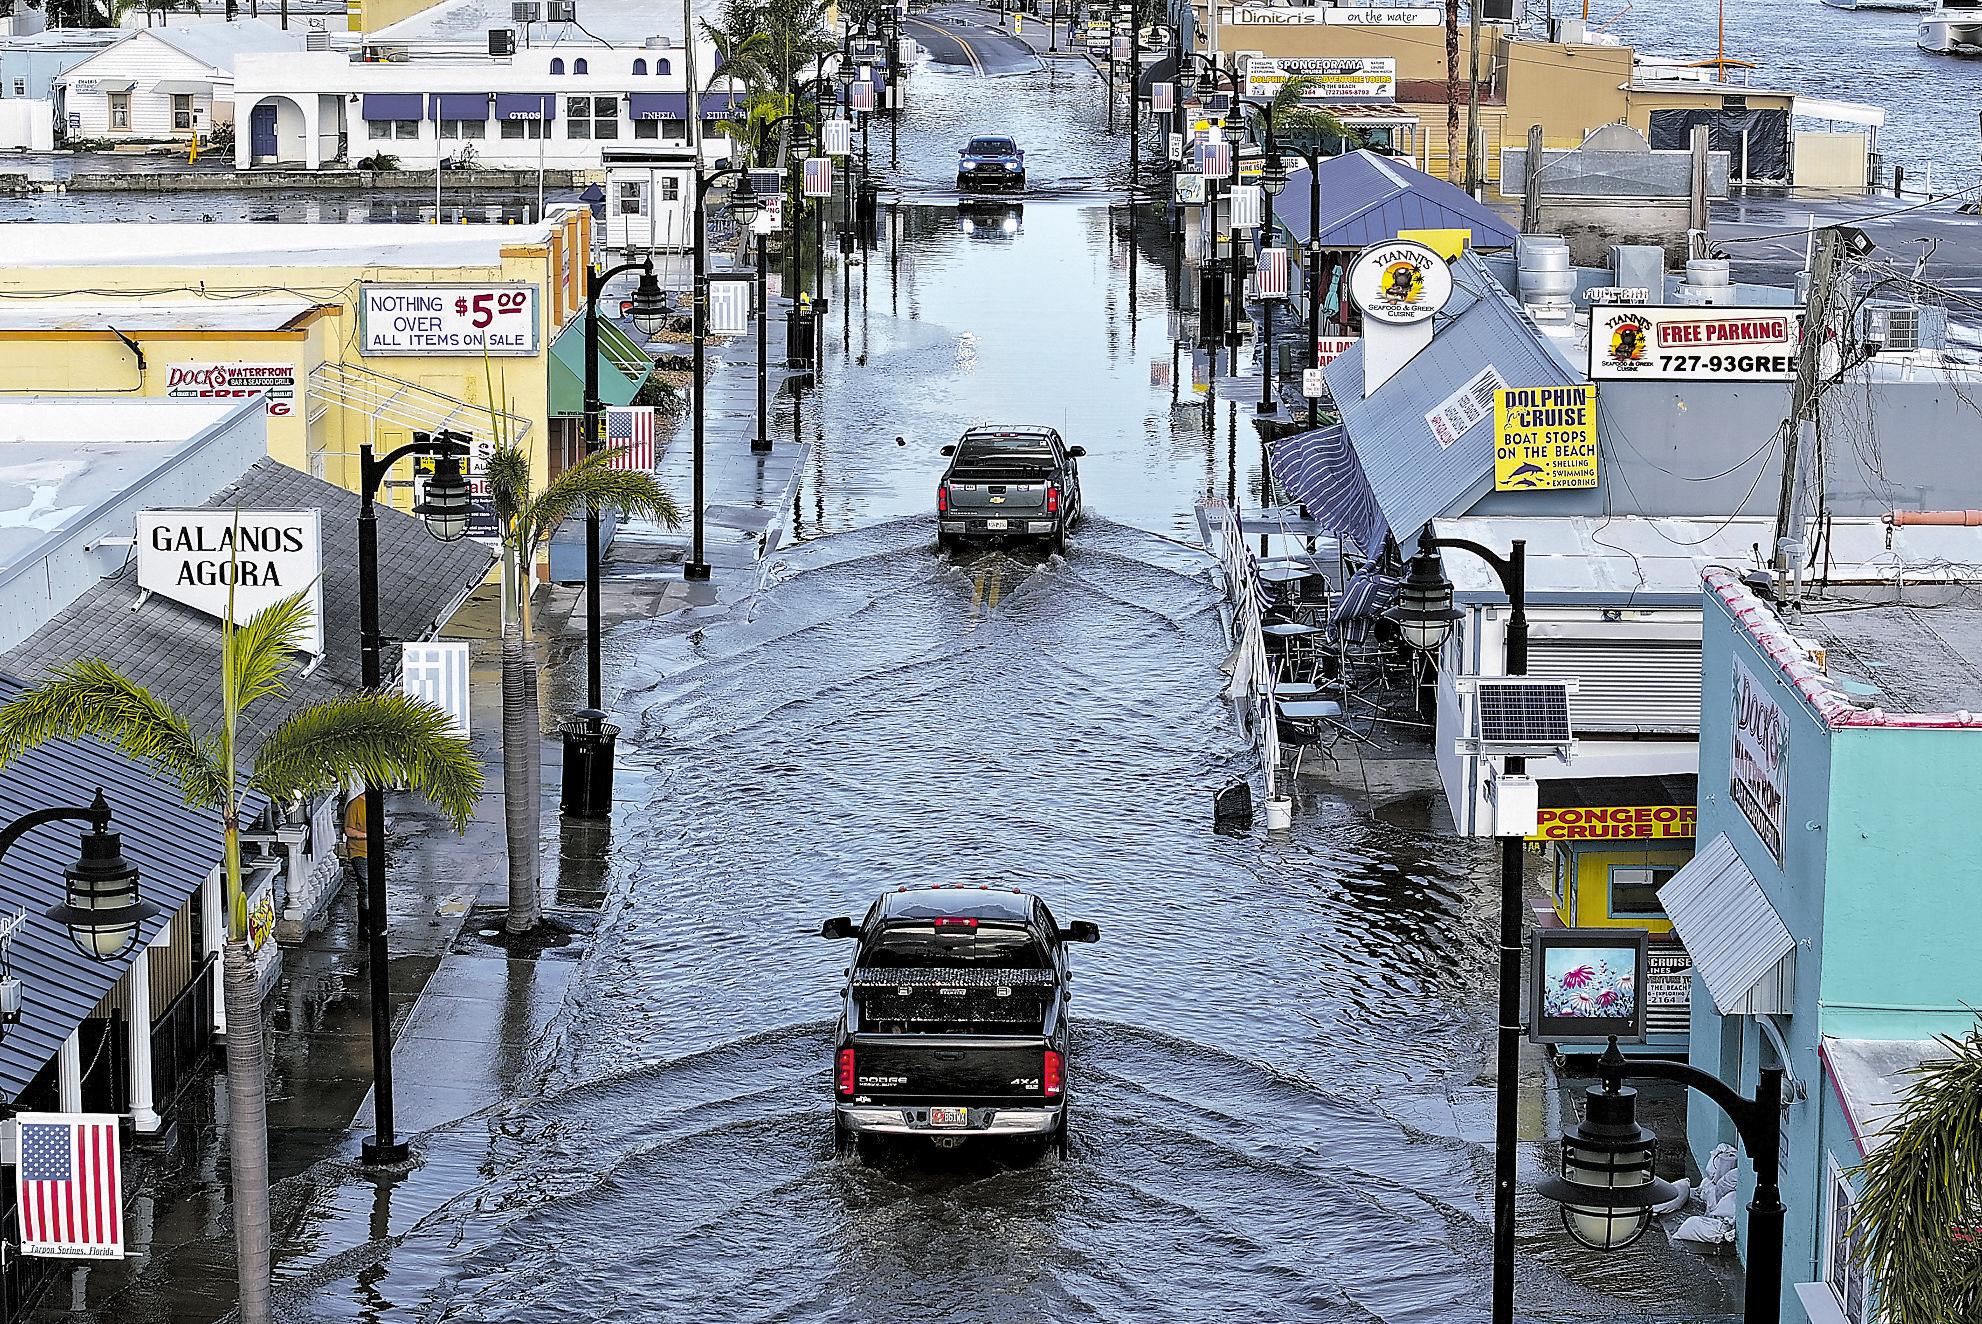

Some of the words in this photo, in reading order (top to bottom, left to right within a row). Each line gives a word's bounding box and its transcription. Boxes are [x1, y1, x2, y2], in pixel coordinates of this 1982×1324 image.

[1348, 14, 1364, 23] on
[1365, 10, 1383, 24] the
[1387, 13, 1417, 23] water
[1277, 60, 1364, 69] SPONGEORAMA
[509, 112, 541, 120] GYROS
[1171, 147, 1180, 157] 15
[371, 296, 443, 312] NOTHING
[394, 317, 442, 332] OVER
[1662, 325, 1702, 342] FREE
[1705, 321, 1783, 342] PARKING
[373, 334, 401, 346] ALL
[410, 334, 459, 346] ITEMS
[463, 334, 483, 346] ON
[489, 334, 525, 346] SALE
[228, 367, 293, 377] WATERFRONT
[231, 378, 243, 386] BAR
[248, 378, 274, 386] SEAFOOD
[275, 378, 291, 386] GRILL
[1505, 388, 1586, 408] DOLPHIN
[1520, 408, 1586, 427] CRUISE
[1504, 432, 1538, 446] BOAT
[1545, 431, 1586, 444] STOPS
[1497, 447, 1516, 459] ON
[1524, 446, 1547, 458] THE
[1555, 444, 1595, 457] BEACH
[1552, 460, 1589, 468] SHELLING
[1552, 469, 1595, 477] SWIMMING
[1552, 479, 1596, 487] EXPLORING
[152, 526, 303, 552] GALANOS
[175, 560, 282, 587] AGORA
[1545, 824, 1653, 839] CRUISE
[1650, 958, 1692, 967] CRUISE
[859, 1076, 908, 1084] DODGE
[89, 1247, 114, 1256] Florida
